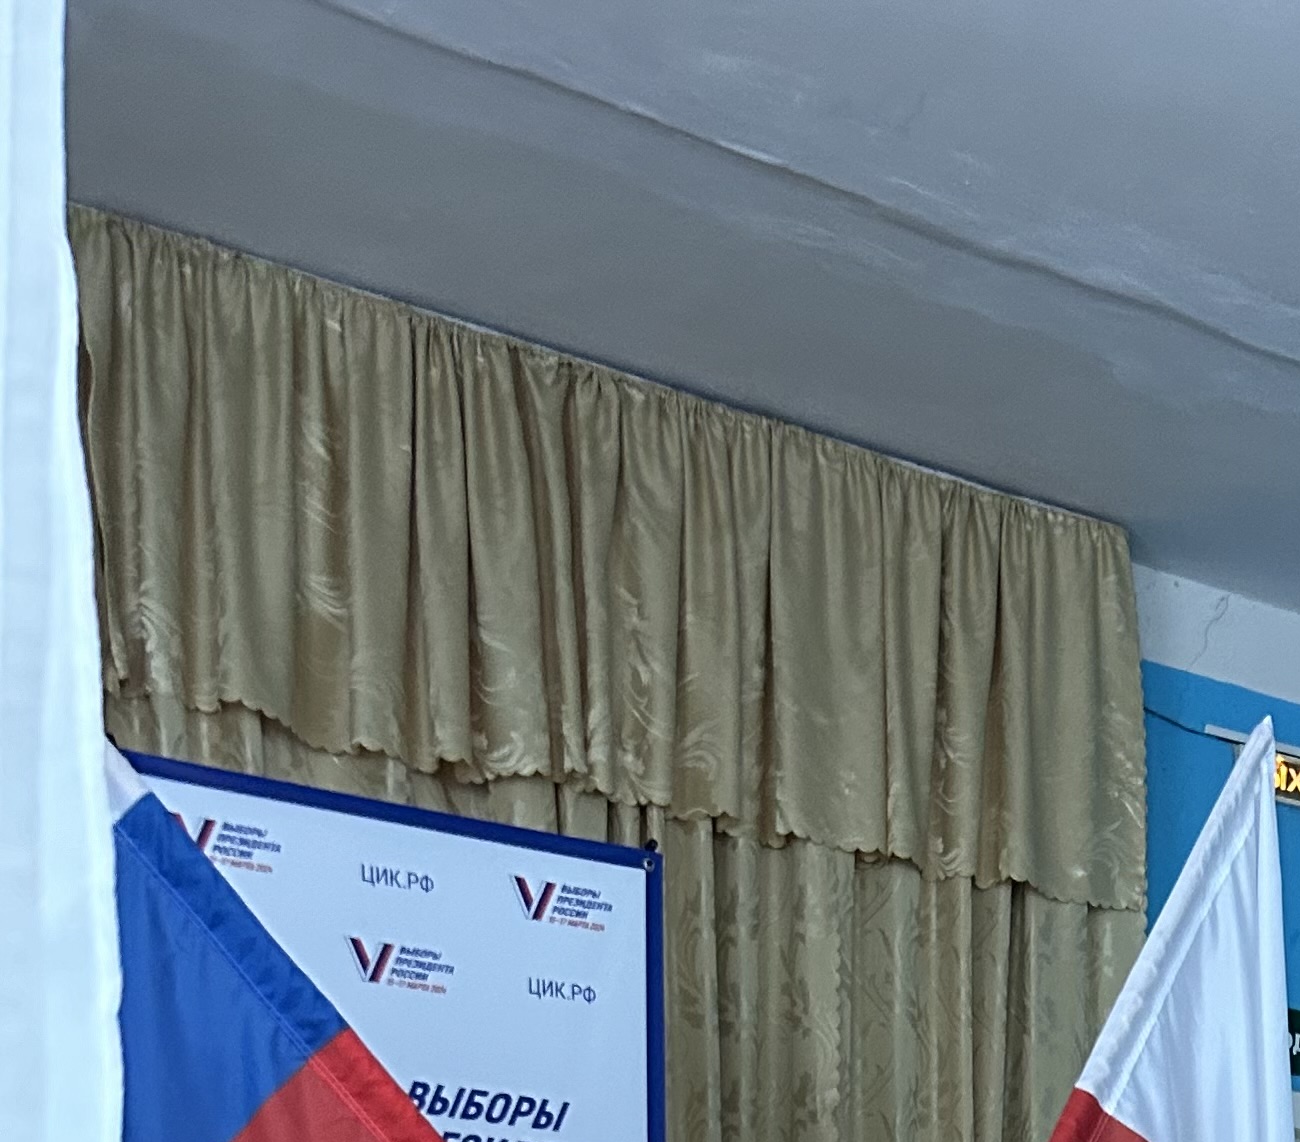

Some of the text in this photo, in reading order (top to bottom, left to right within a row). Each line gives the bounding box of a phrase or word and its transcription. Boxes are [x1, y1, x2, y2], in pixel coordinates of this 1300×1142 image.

[361, 863, 435, 892] ЦИК.РФ
[528, 976, 597, 1004] ЦИК.РФ
[409, 1080, 570, 1132] ВЫБОРЫ
